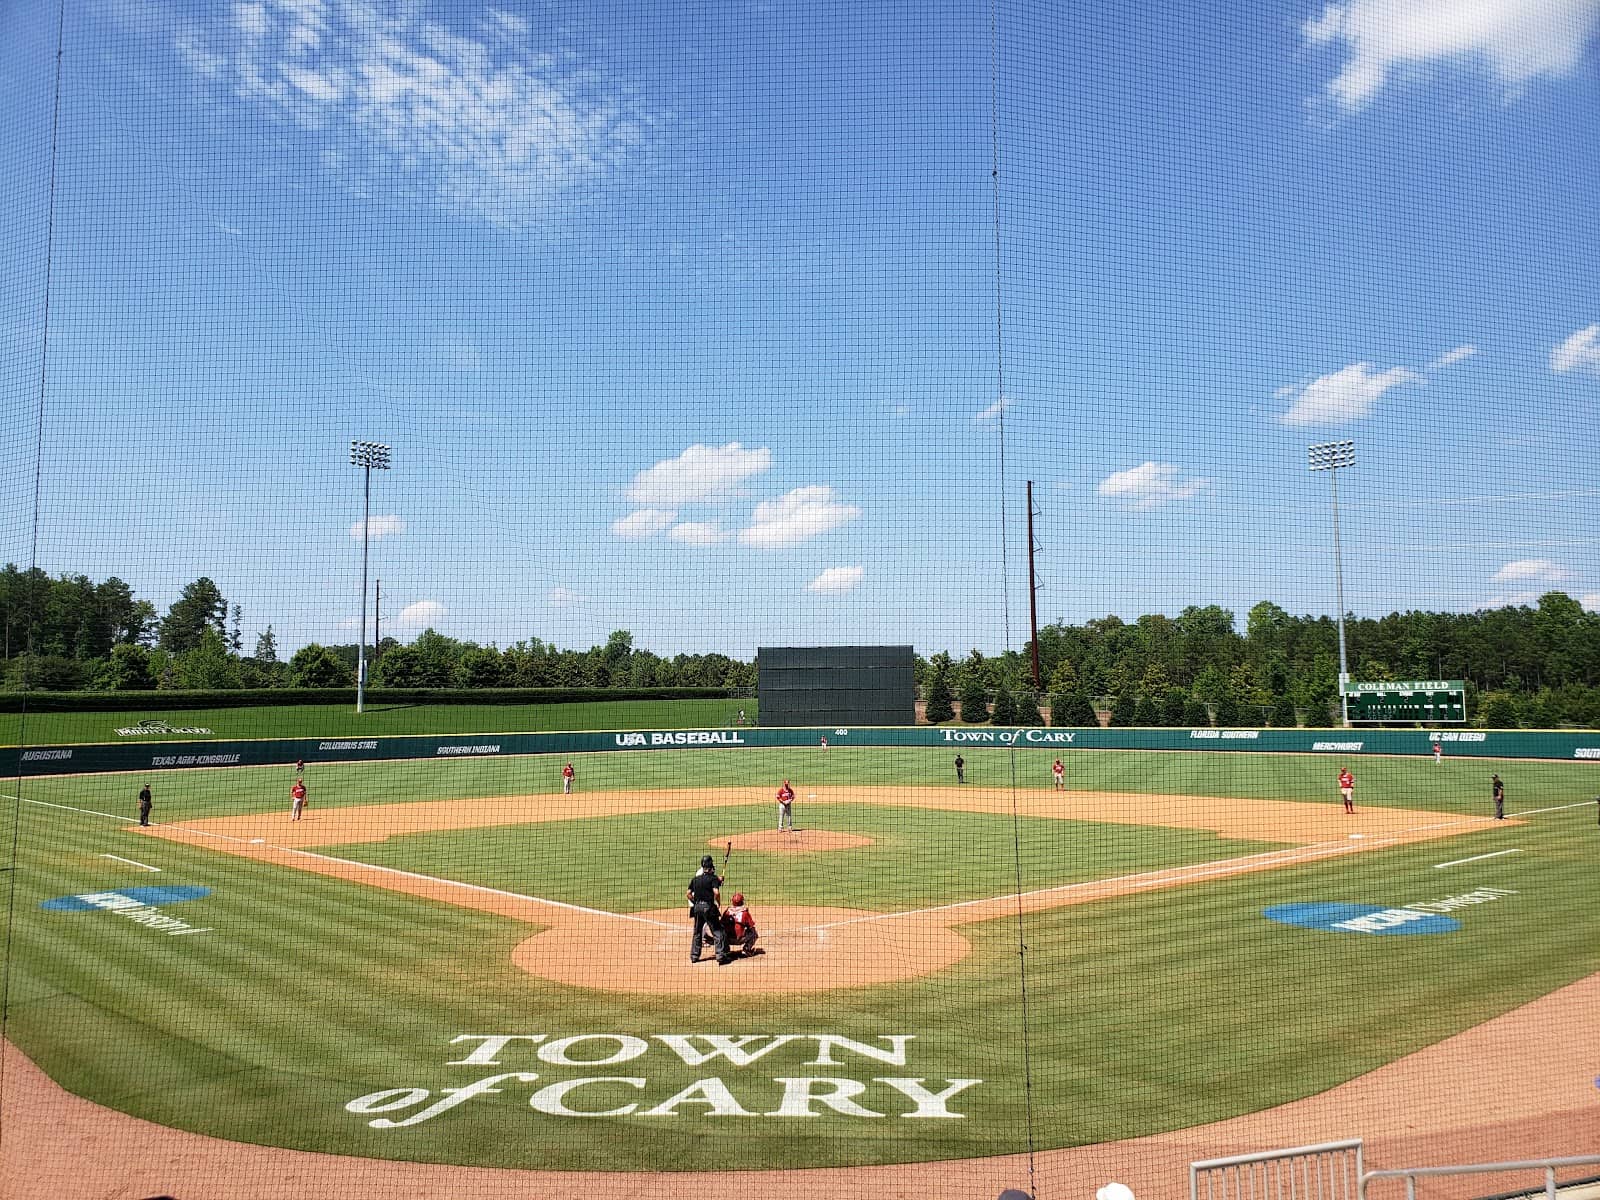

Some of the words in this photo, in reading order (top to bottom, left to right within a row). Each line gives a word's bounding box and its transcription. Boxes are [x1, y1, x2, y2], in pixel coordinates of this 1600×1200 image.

[1357, 683, 1410, 691] COLEMAN
[1414, 682, 1449, 690] FIELD
[834, 728, 848, 736] 400
[939, 728, 995, 742] TOWN
[999, 728, 1024, 746] of
[1025, 729, 1076, 743] CARY
[1190, 730, 1220, 739] FLORIDA
[1221, 730, 1259, 739] SOUTHERN
[1429, 732, 1441, 741] UC
[1441, 732, 1458, 741] SAN
[1458, 732, 1486, 742] DIEGO
[651, 731, 745, 745] BASEBALL
[318, 741, 357, 750] COLUMBUS
[357, 741, 378, 750] STATE
[436, 746, 471, 755] SOUTHERN
[471, 745, 501, 754] INDIANA
[1312, 742, 1364, 751] MERCYHURST
[21, 749, 73, 761] AUGUSTANA
[151, 755, 176, 766] TEXAS
[446, 1034, 917, 1066] TOWN
[344, 1071, 538, 1129] of
[529, 1076, 984, 1119] CARY
